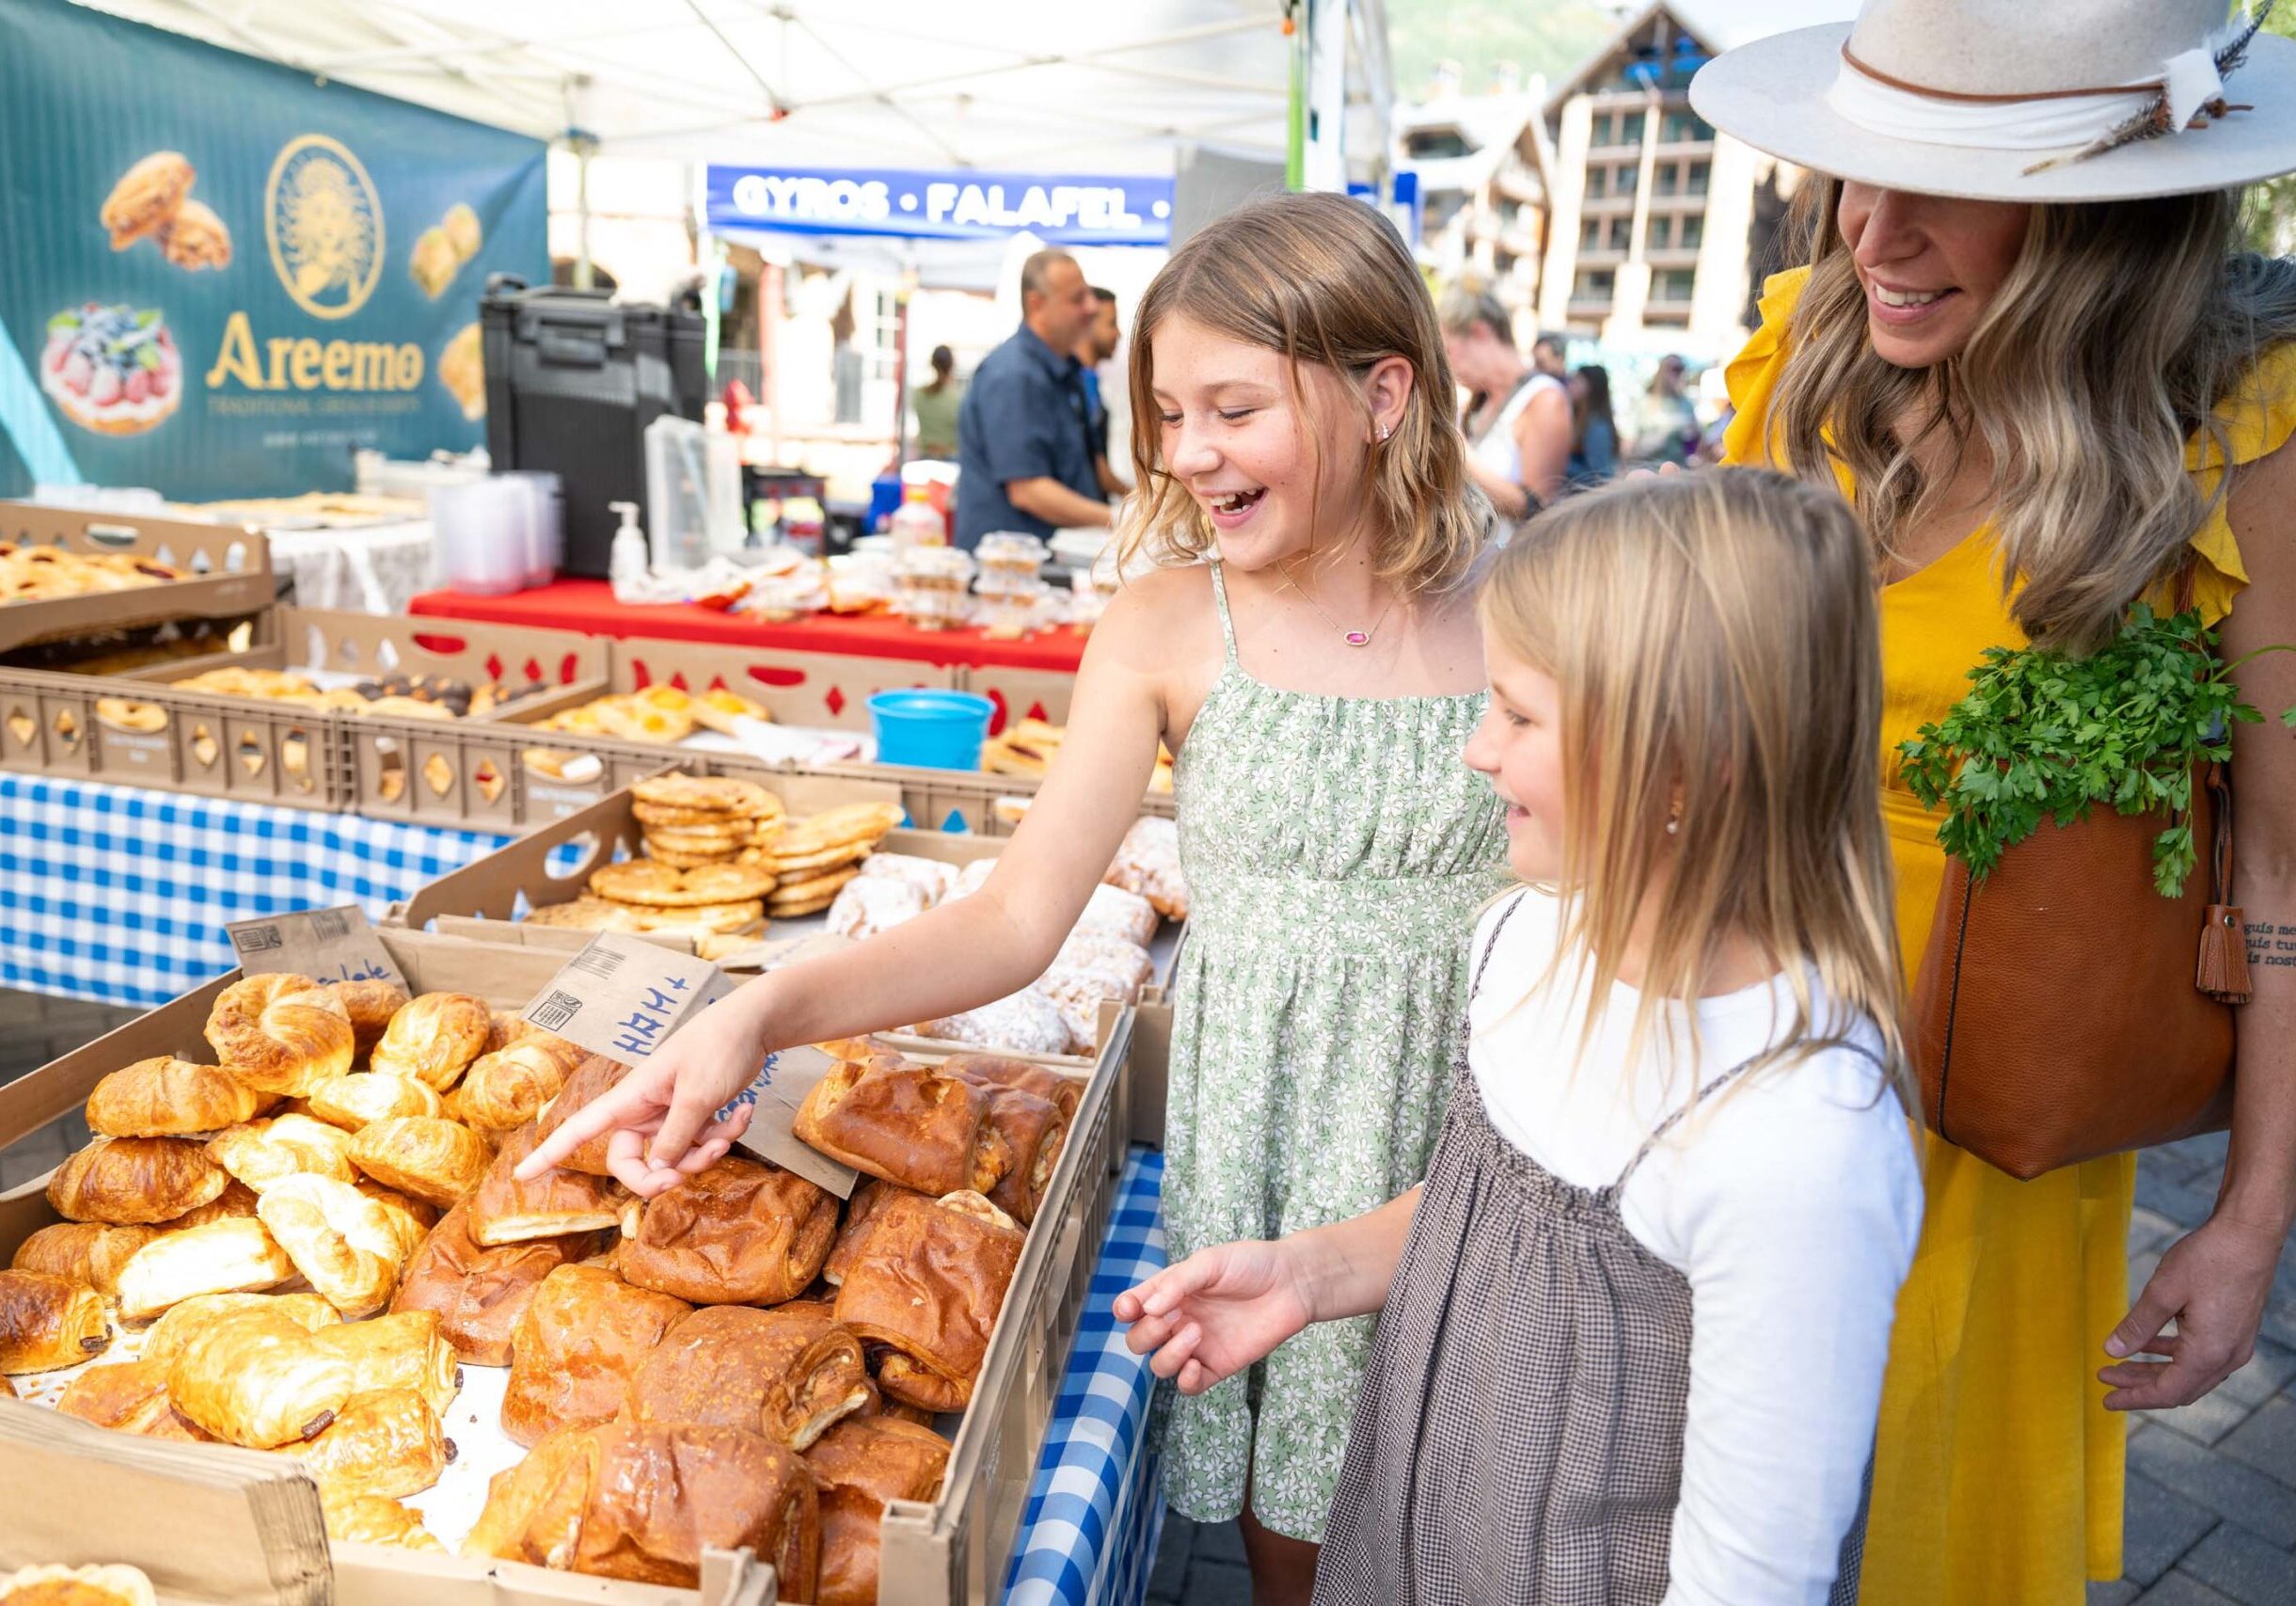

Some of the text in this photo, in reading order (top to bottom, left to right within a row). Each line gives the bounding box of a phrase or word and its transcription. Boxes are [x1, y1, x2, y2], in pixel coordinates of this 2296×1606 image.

[733, 175, 1142, 230] GYROS FALAFEL
[205, 310, 424, 390] Areemo
[612, 988, 678, 1057] HAM
